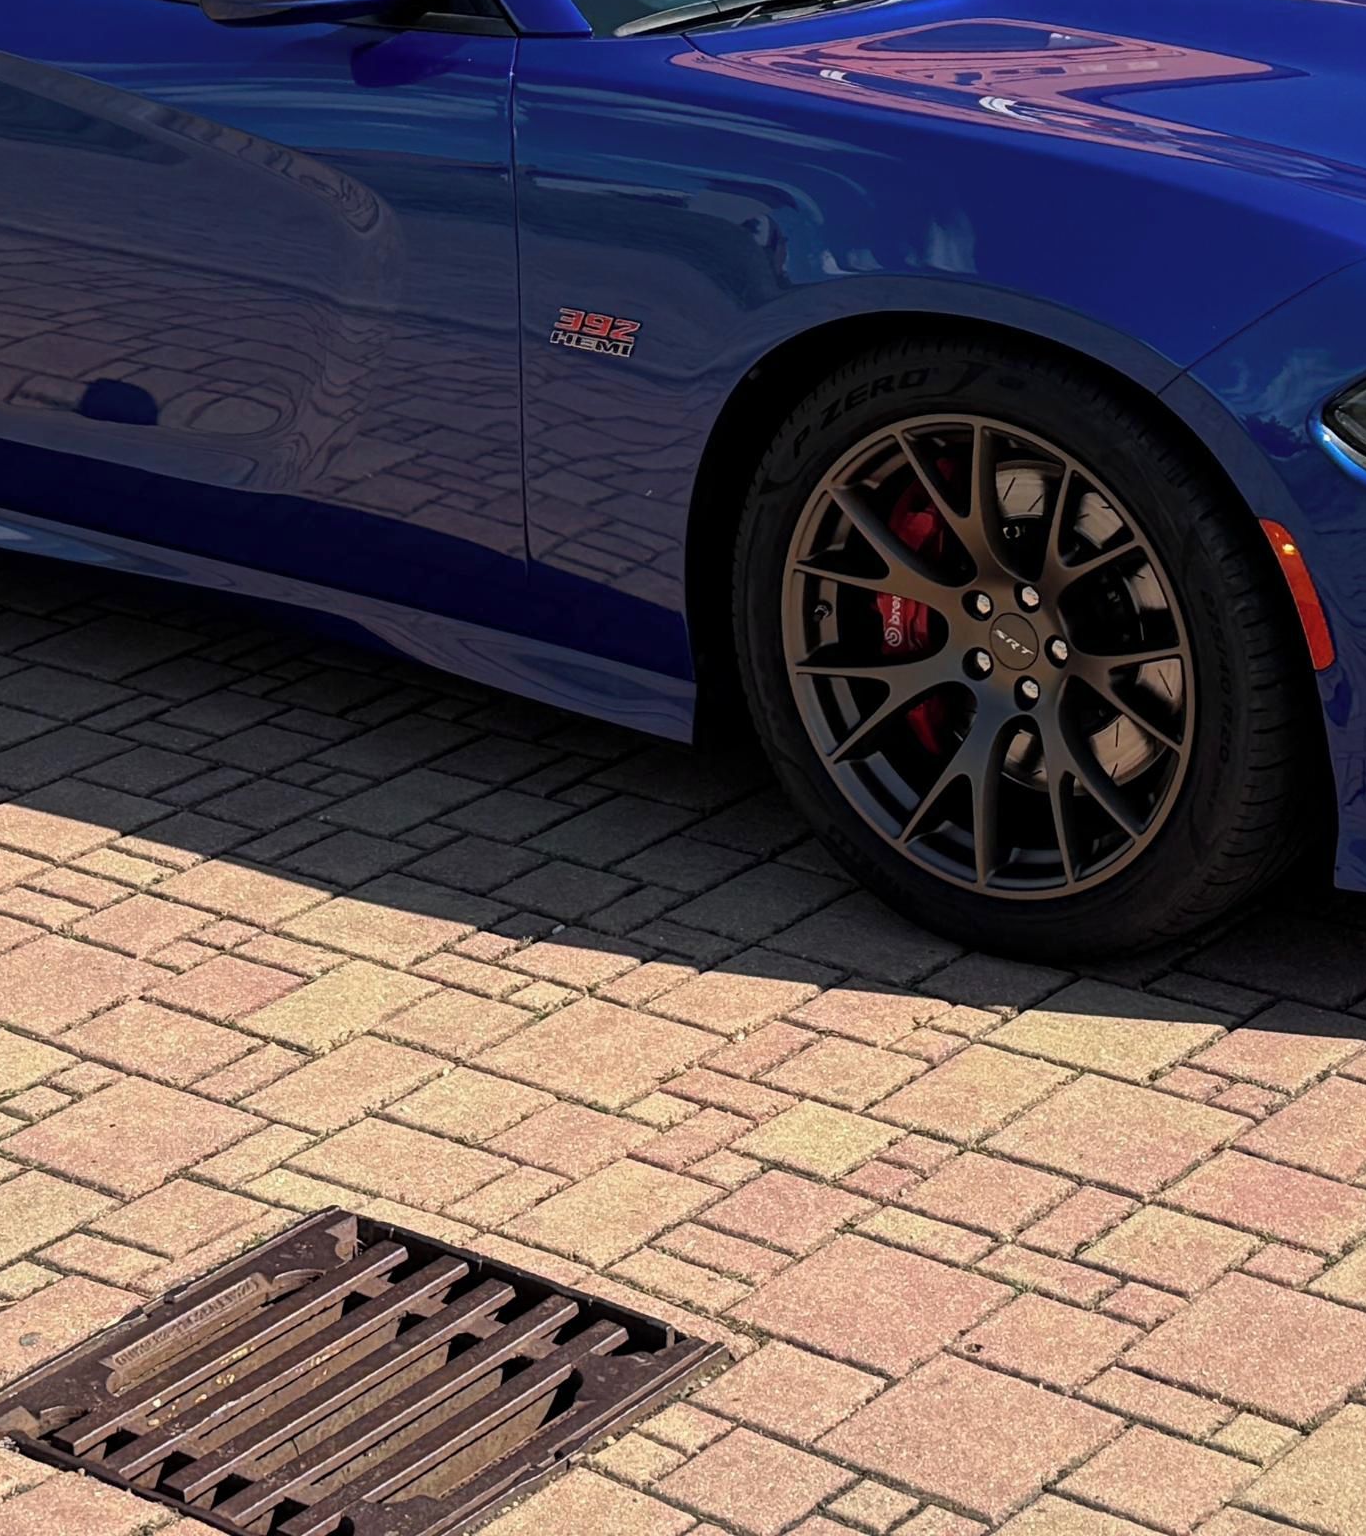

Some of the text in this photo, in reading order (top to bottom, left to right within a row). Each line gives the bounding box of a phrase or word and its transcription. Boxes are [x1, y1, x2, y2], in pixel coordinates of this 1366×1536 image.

[553, 307, 641, 343] 392
[549, 330, 635, 358] HEMI
[820, 368, 927, 429] ZERO
[993, 628, 1034, 656] SRT
